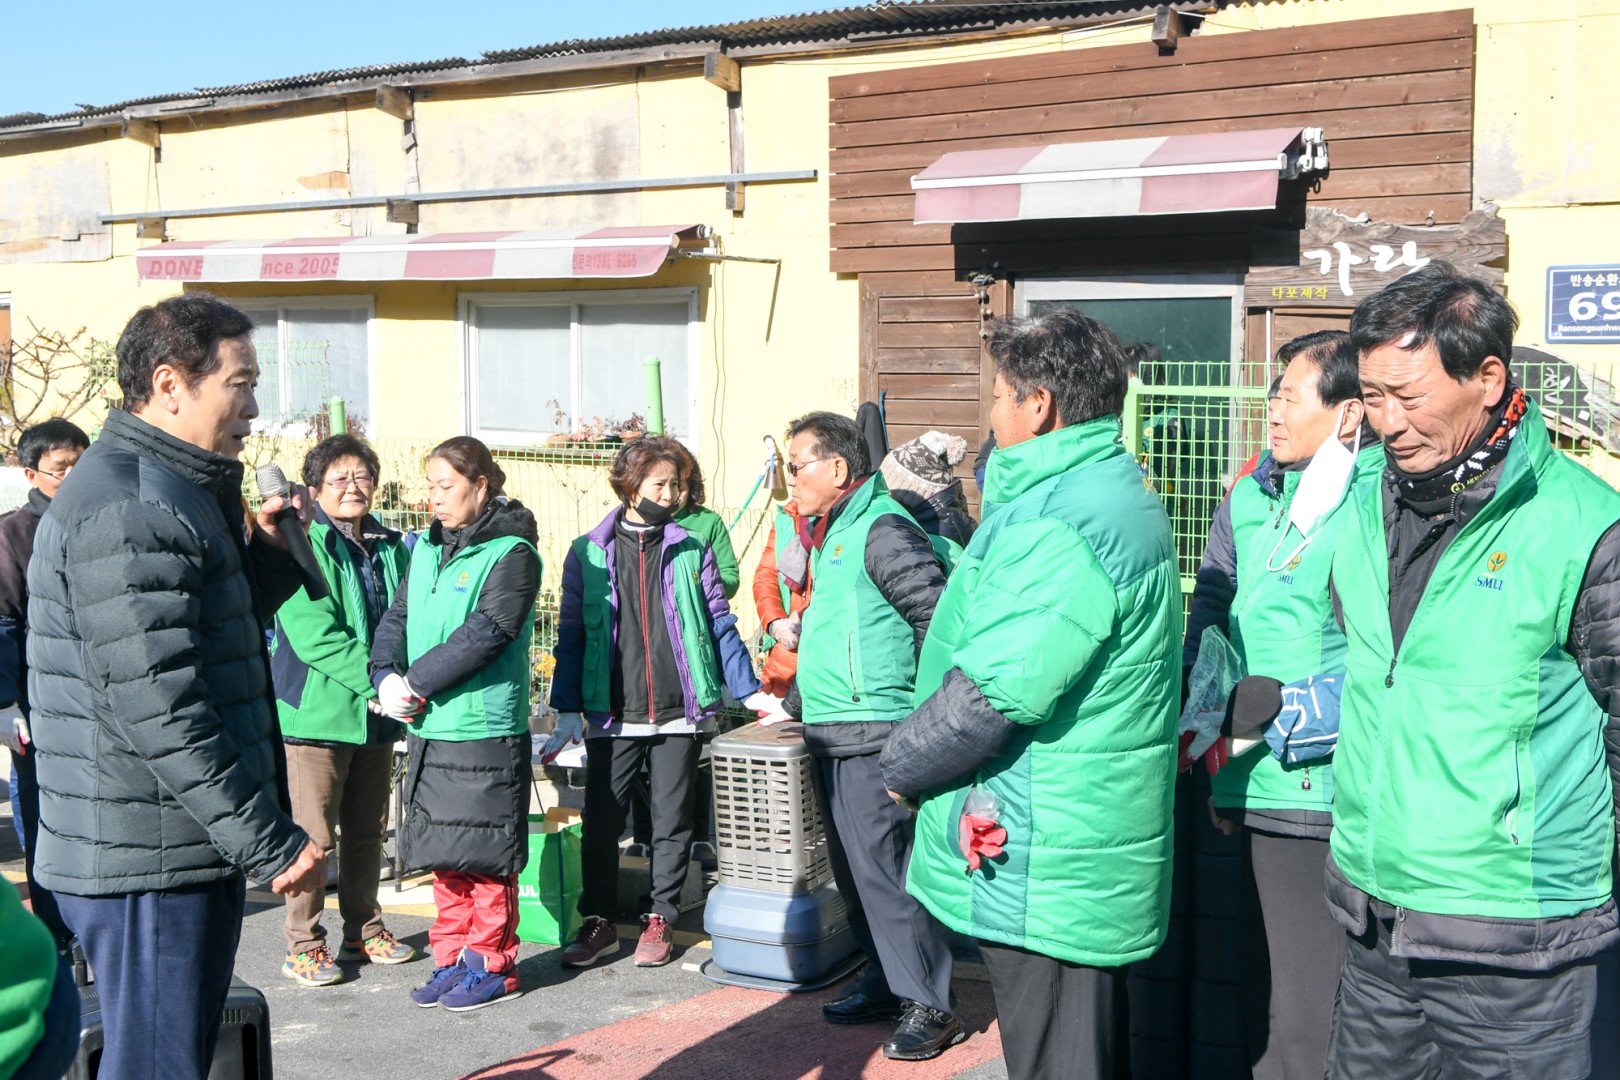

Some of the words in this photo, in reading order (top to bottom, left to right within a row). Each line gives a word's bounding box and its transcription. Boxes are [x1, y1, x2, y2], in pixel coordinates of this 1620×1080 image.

[1570, 274, 1620, 286] 반송순환
[1272, 287, 1328, 300] 다포제작
[1474, 576, 1504, 591] SMU
[518, 884, 538, 897] UL
